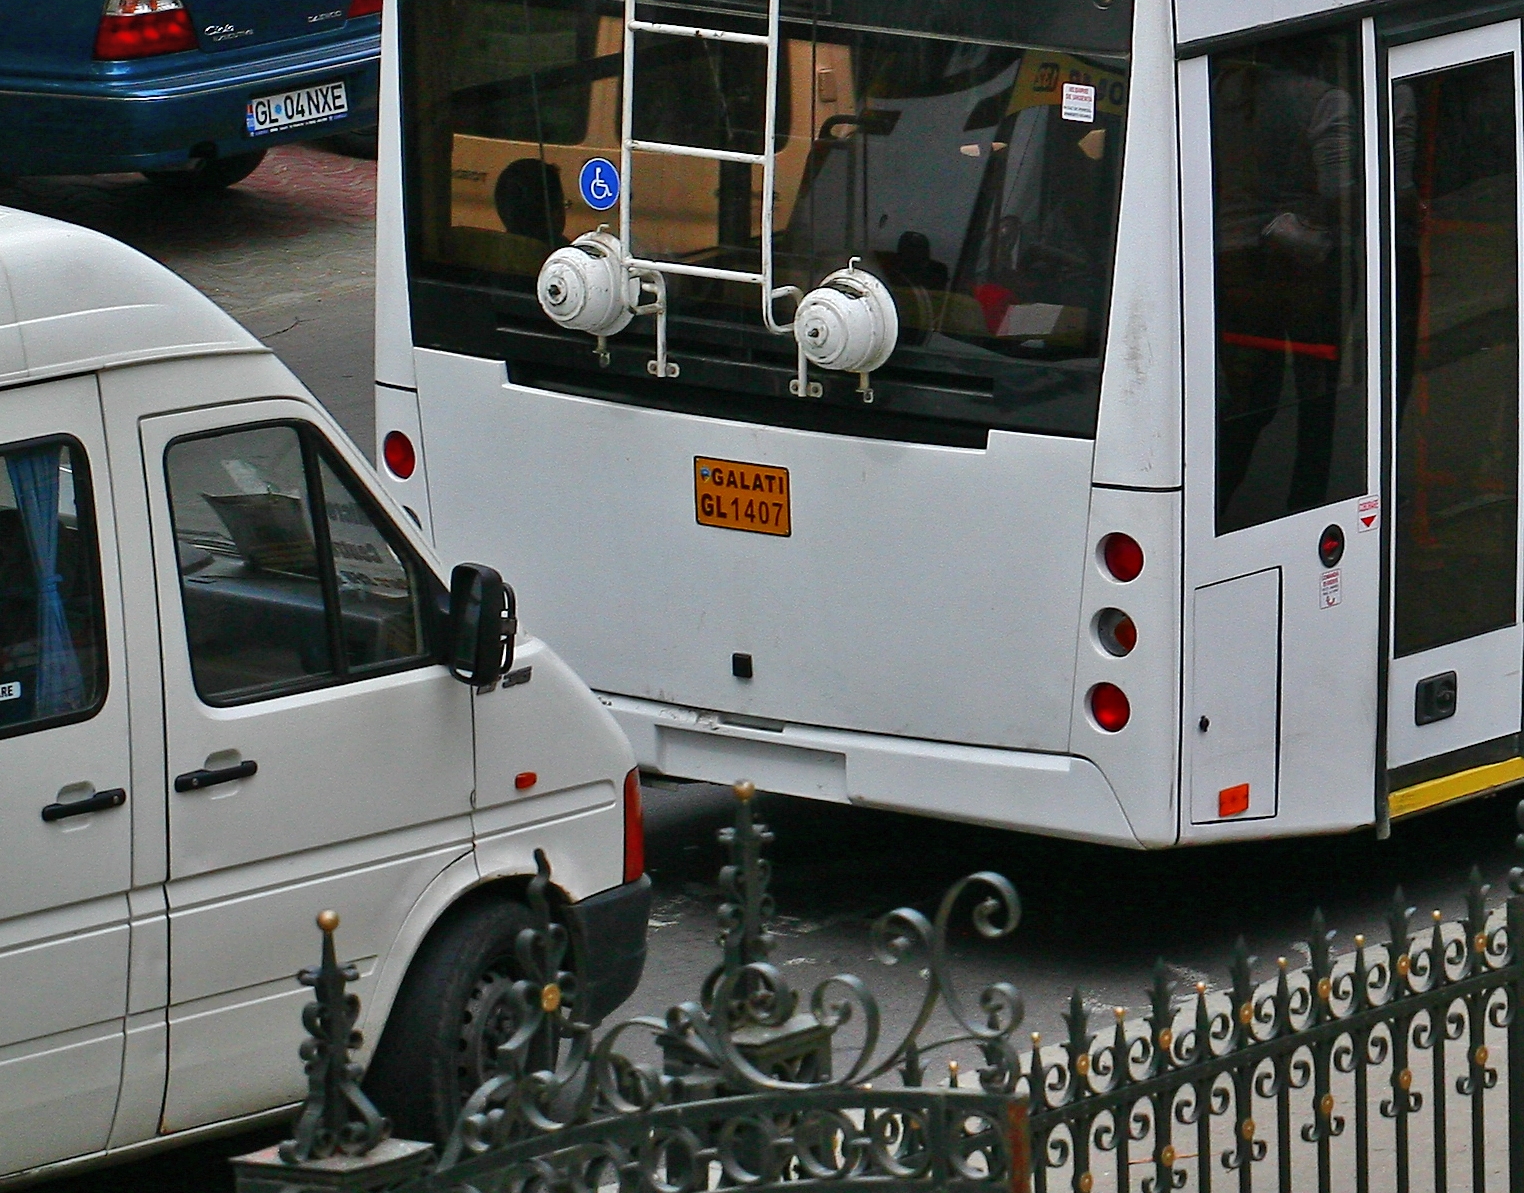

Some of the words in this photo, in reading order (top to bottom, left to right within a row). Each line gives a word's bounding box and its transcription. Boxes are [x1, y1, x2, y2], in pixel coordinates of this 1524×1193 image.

[255, 99, 279, 126] GL
[712, 467, 784, 495] GALATI
[701, 492, 784, 527] GL1407
[0, 685, 14, 697] RE
